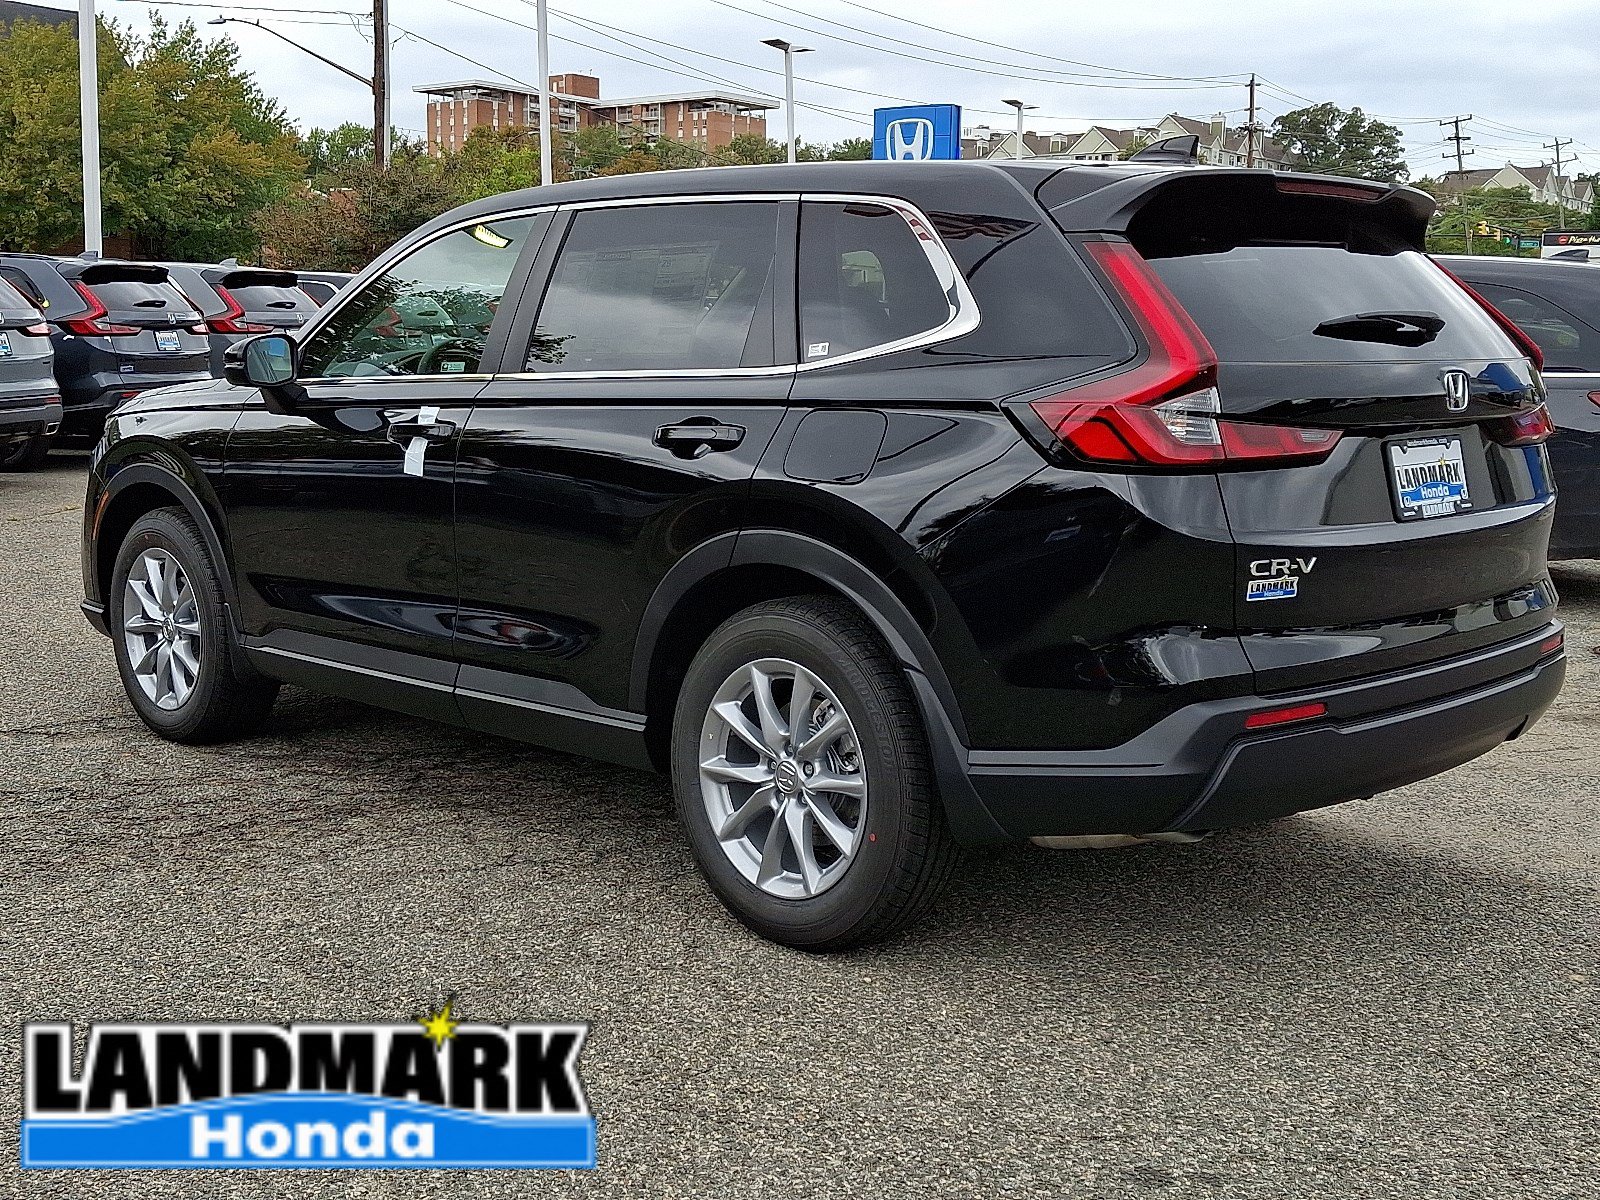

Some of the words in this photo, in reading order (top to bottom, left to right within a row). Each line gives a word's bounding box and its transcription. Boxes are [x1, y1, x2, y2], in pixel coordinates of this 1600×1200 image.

[1396, 462, 1461, 489] LANDMARK
[1421, 484, 1450, 499] Honda
[1249, 556, 1318, 576] CR-V
[1250, 580, 1295, 594] LANDMARK
